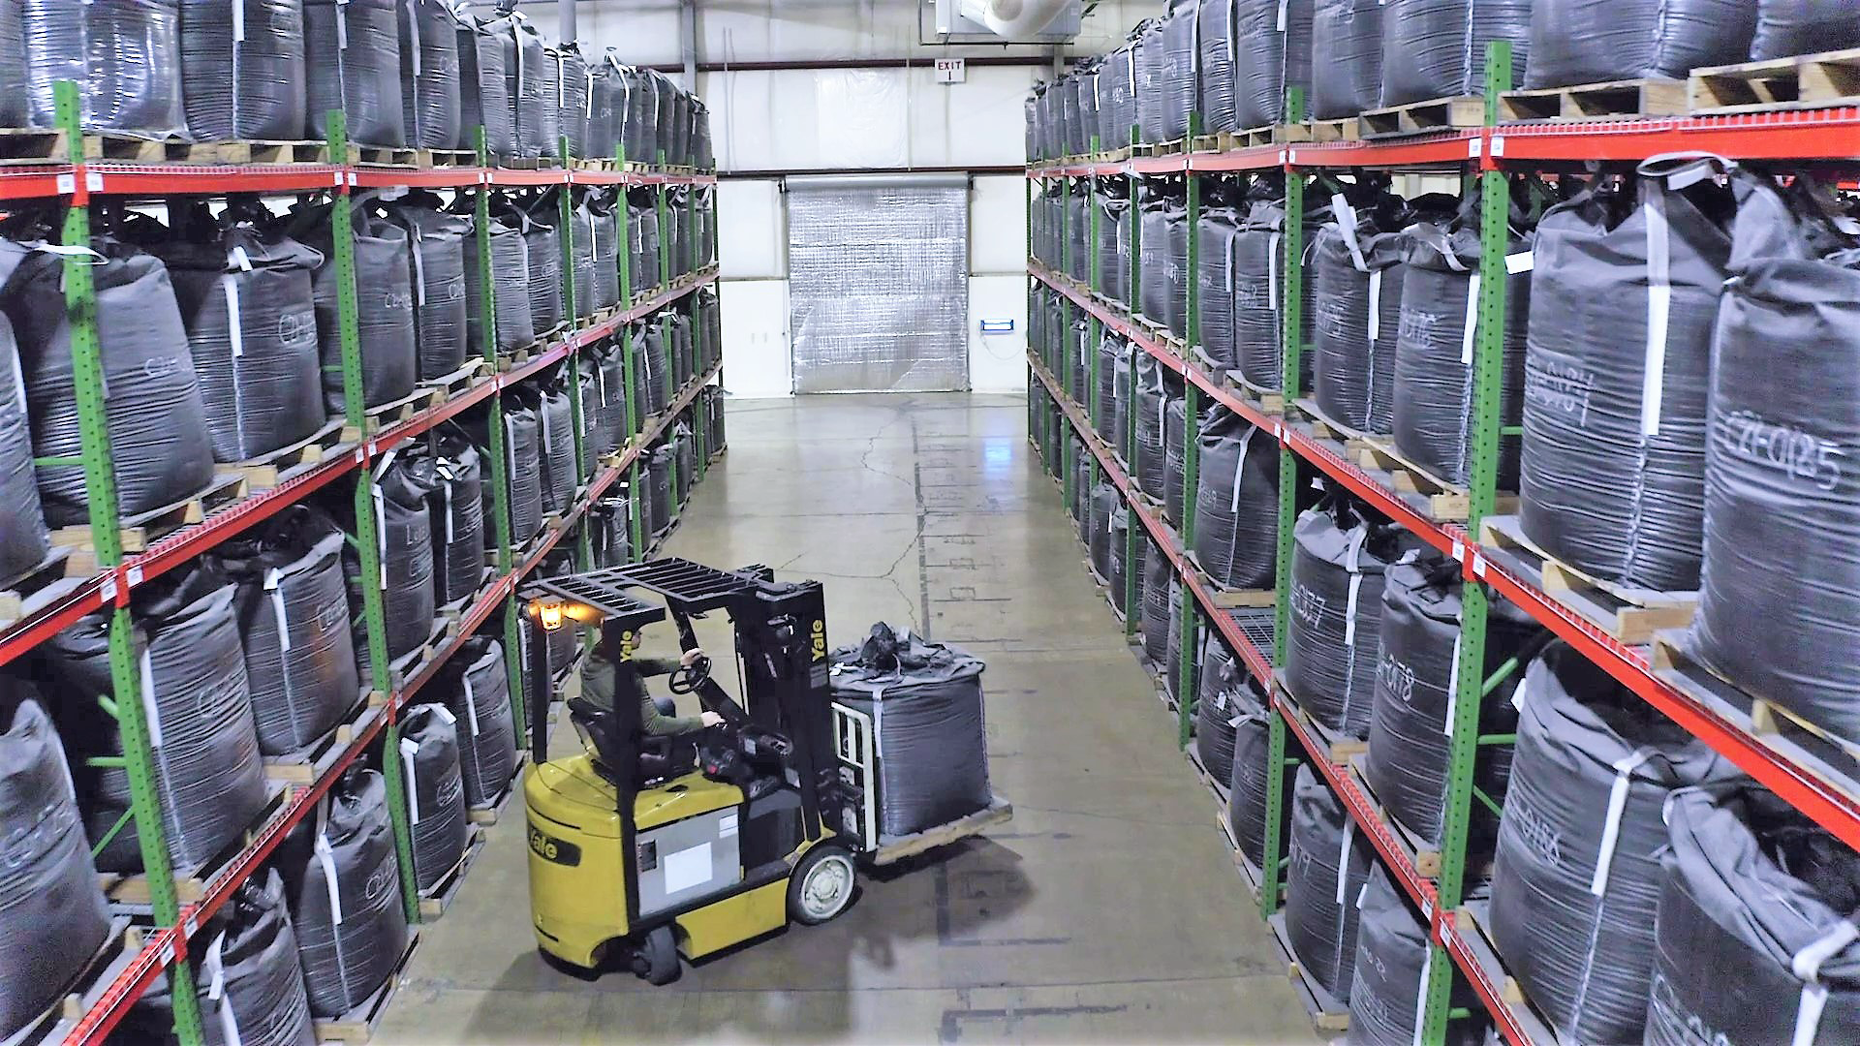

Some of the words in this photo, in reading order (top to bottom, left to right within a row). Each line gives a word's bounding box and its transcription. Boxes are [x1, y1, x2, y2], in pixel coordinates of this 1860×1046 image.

[938, 61, 961, 70] EXIT
[620, 630, 632, 663] Yale
[811, 619, 825, 662] Yale
